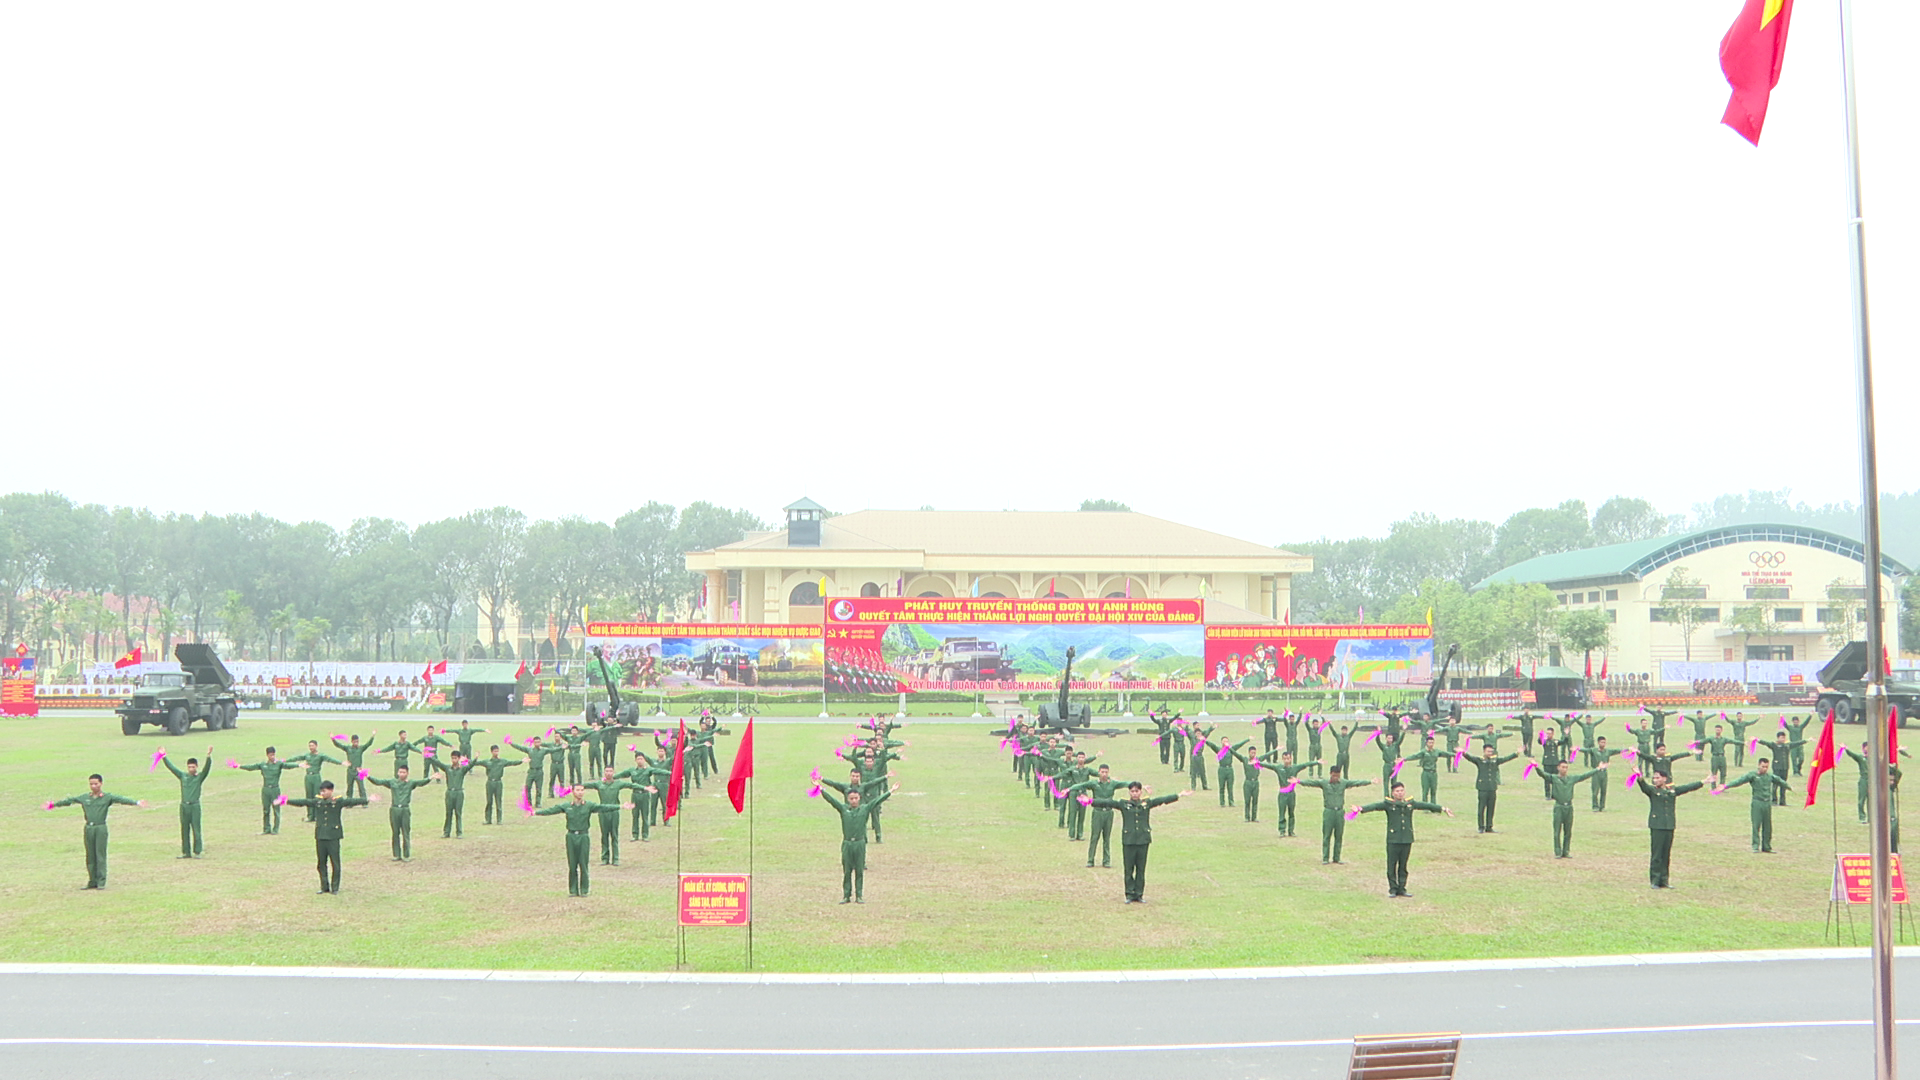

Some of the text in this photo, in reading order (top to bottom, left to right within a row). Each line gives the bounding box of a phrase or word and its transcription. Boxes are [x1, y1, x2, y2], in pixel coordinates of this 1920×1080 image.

[904, 600, 1164, 612] PHÁT HUY TRUYỀN THỐNG ĐƠN VỊ ANH HÙNG
[859, 610, 1195, 622] QUYẾT TÂM THỰC HIỆN THẮNG LỢI NGHỊ QUYẾT ĐẠI HỘI XIV CỦA ĐẢNG
